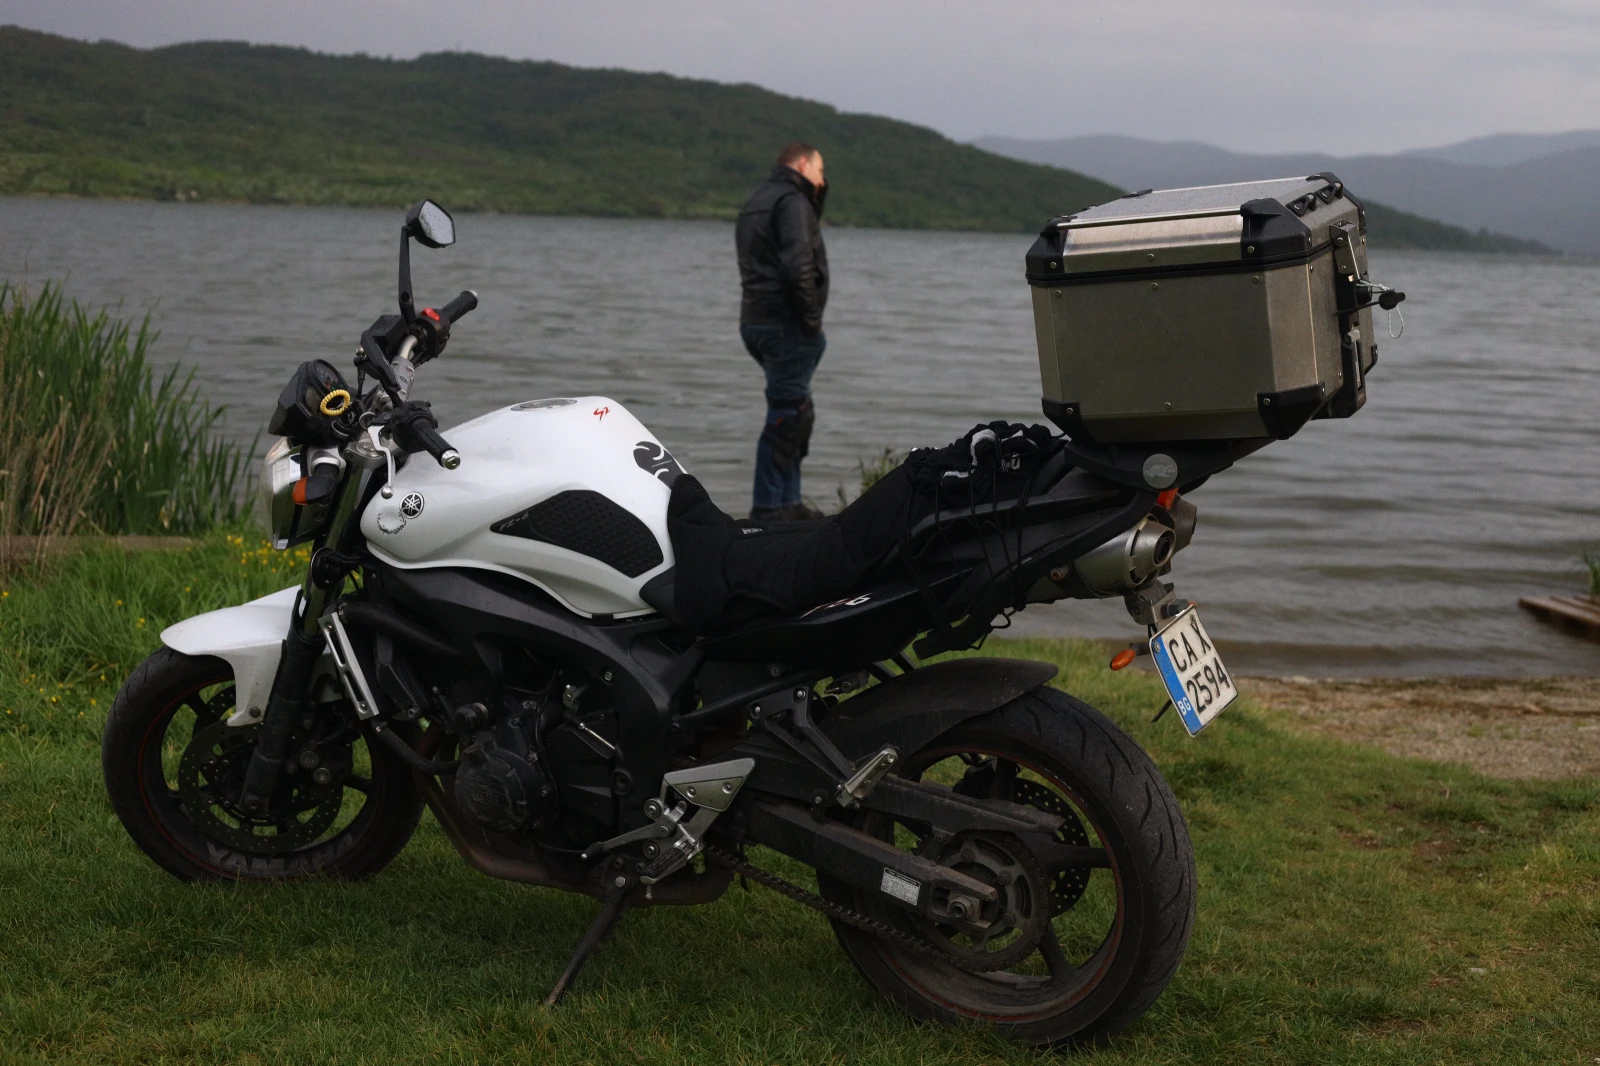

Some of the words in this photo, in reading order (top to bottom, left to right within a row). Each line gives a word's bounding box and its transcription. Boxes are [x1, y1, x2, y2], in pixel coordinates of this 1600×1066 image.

[1169, 632, 1198, 672] CA
[1186, 657, 1230, 713] 2594
[1177, 697, 1192, 716] BG
